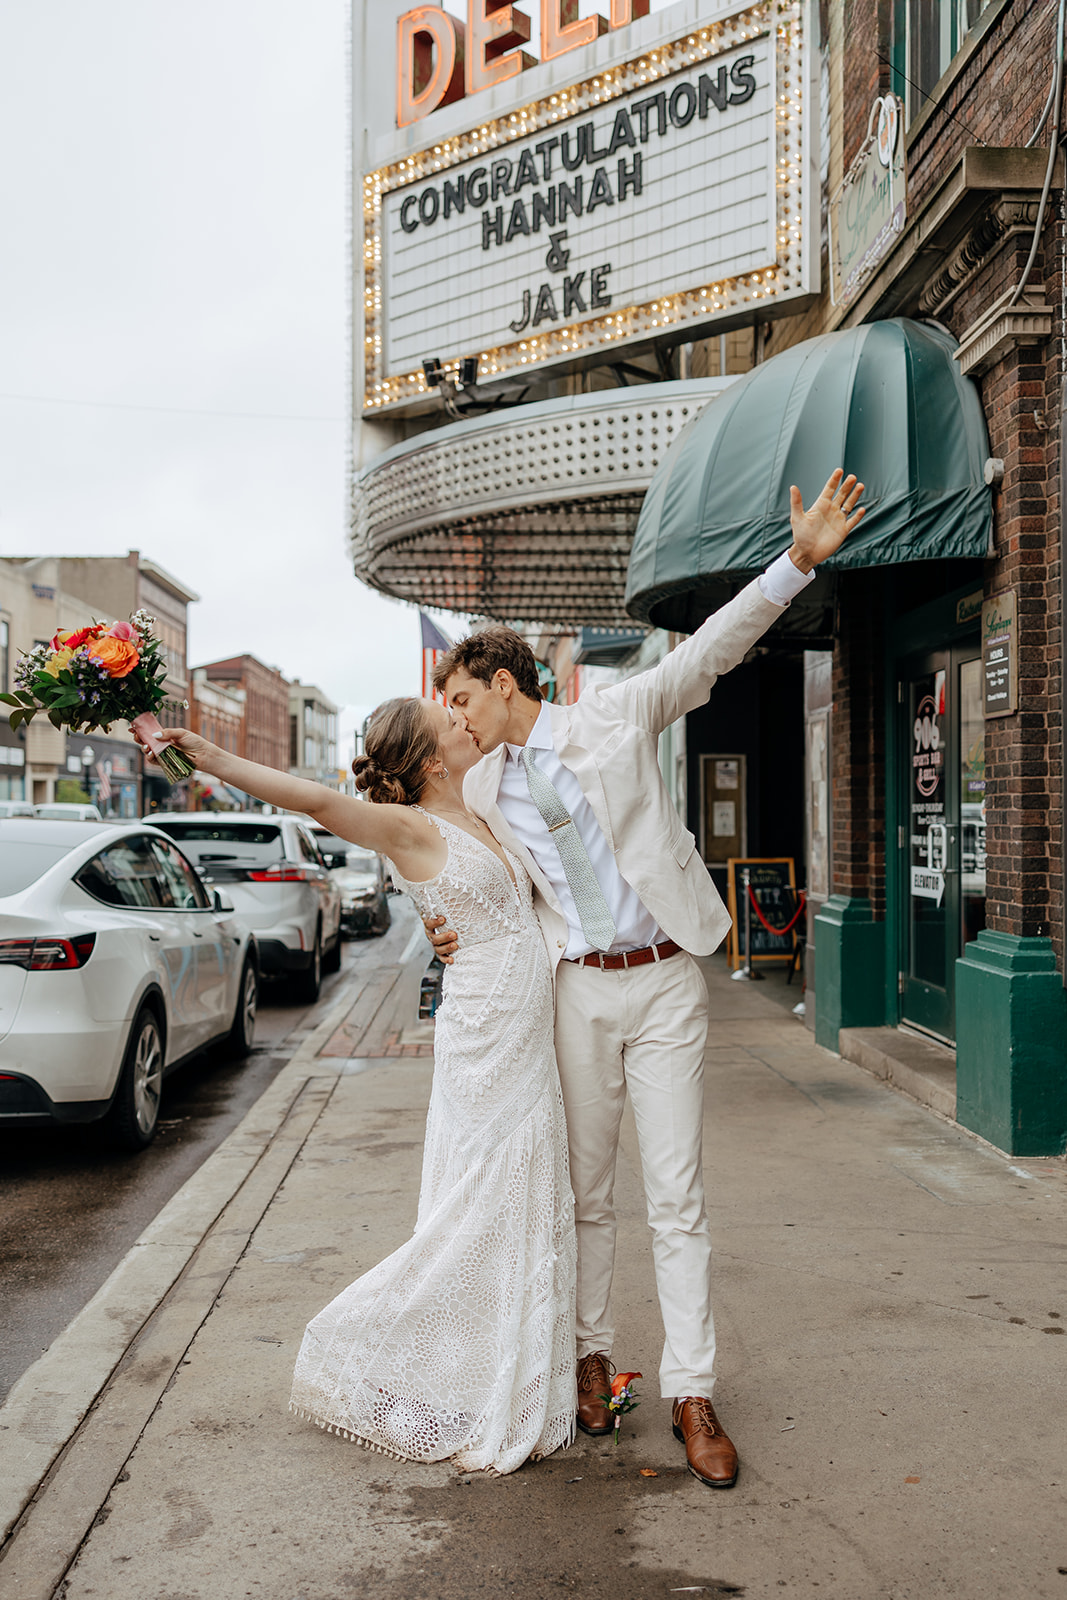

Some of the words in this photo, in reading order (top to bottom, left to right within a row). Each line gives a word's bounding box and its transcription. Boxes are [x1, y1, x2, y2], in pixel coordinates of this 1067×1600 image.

[399, 54, 757, 234] CONGRATULATIONS
[481, 152, 643, 250] HANNAH
[545, 230, 570, 273] &
[508, 263, 613, 333] JAKE
[913, 713, 940, 754] 906
[914, 873, 939, 890] ELEVATOR
